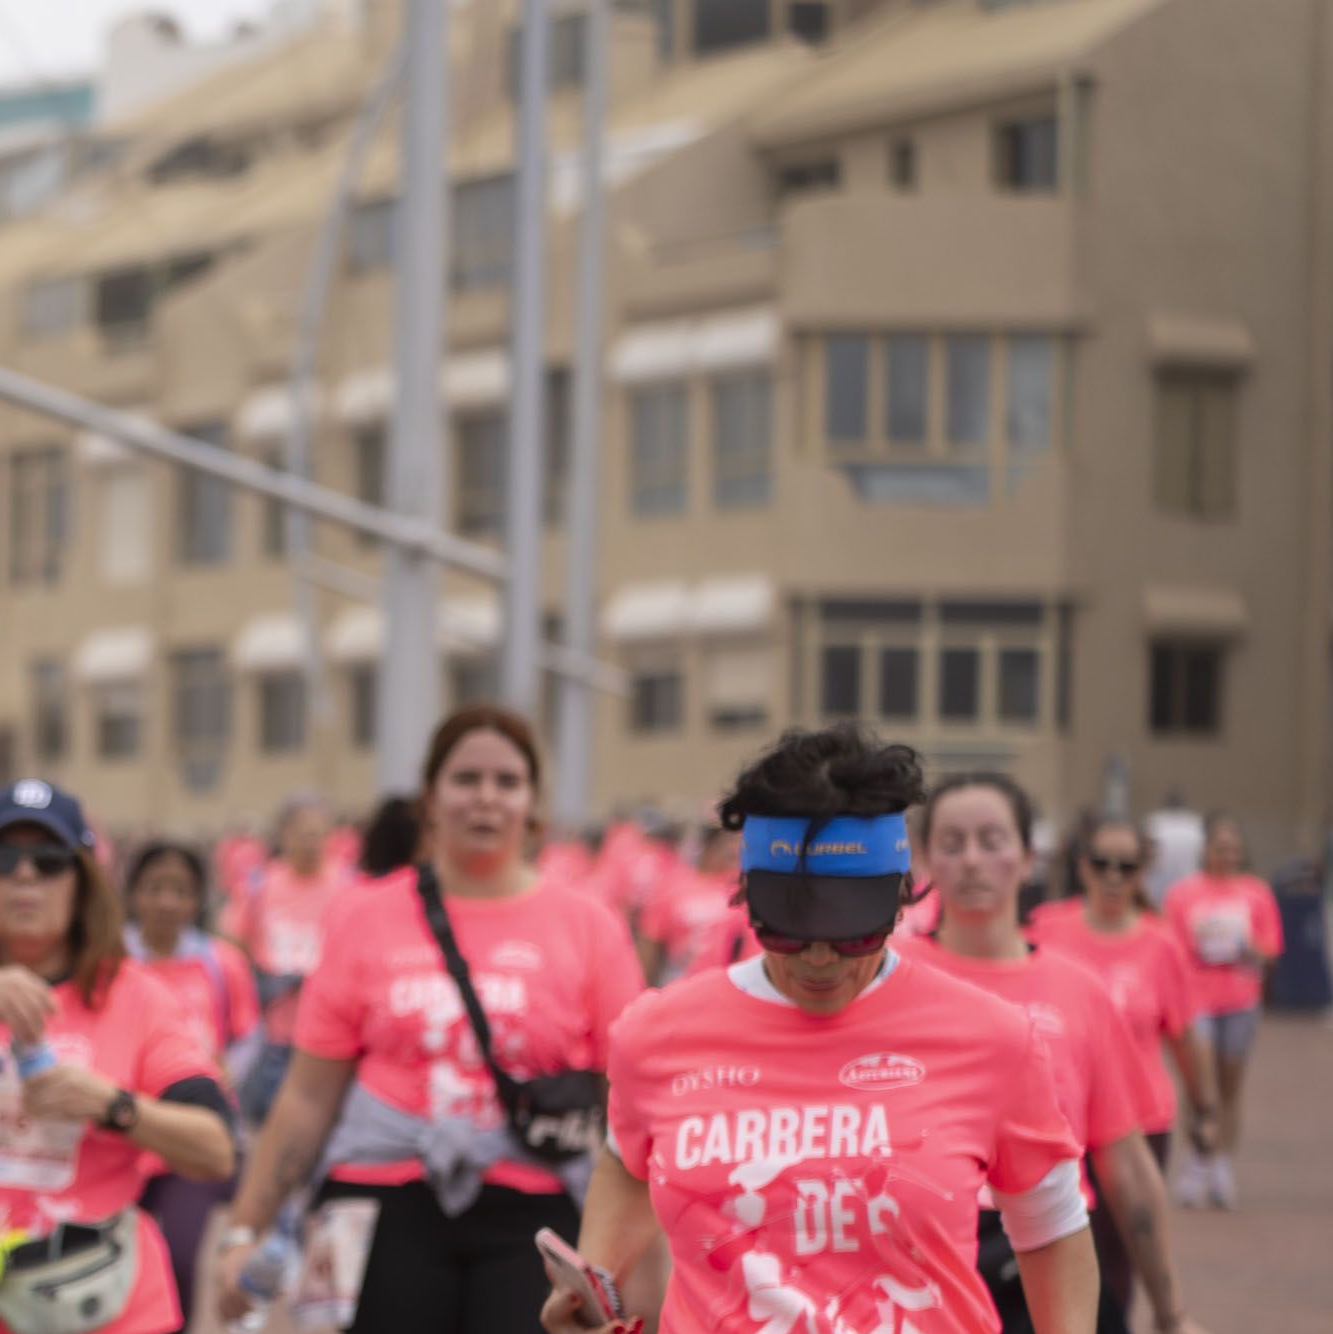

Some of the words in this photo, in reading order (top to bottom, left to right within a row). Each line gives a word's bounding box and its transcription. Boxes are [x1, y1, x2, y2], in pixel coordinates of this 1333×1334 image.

[671, 1065, 762, 1096] OYSHO
[674, 1103, 894, 1172] CARRERA
[793, 1178, 860, 1256] DE
